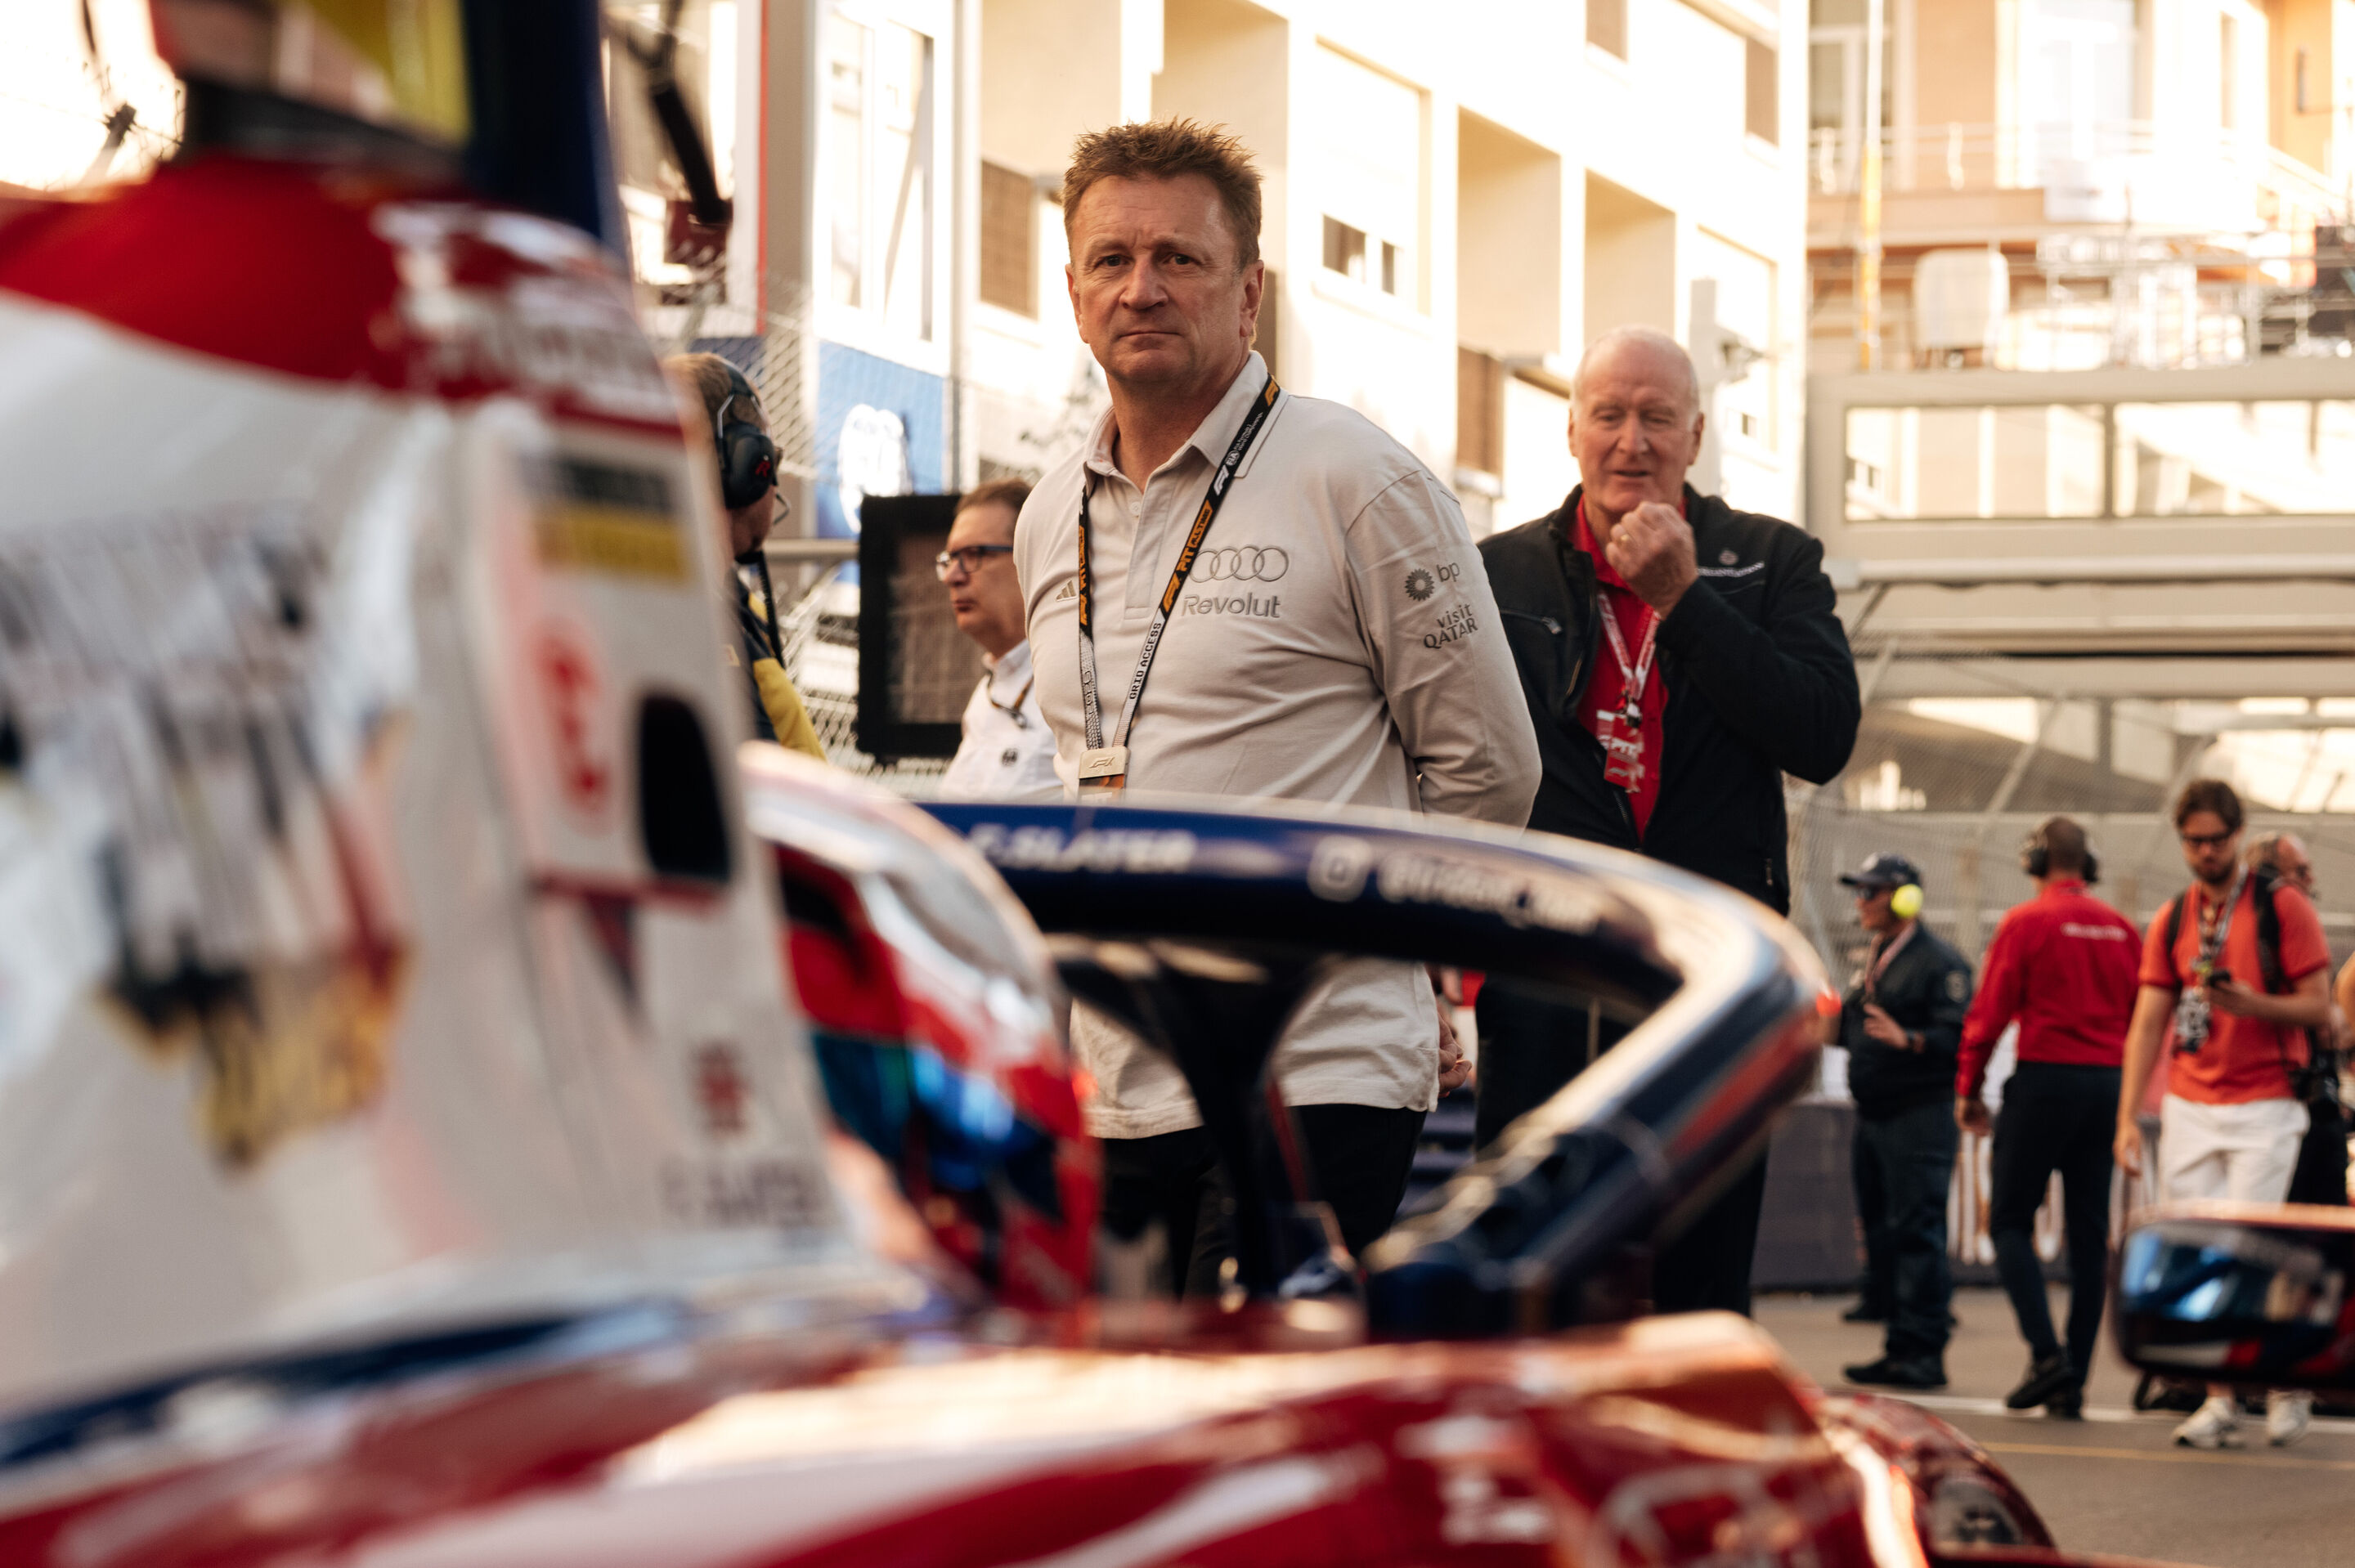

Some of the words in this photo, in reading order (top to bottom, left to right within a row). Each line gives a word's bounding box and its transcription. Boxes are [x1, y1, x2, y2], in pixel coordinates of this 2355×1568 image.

[1176, 547, 1195, 571] PIT
[1437, 562, 1460, 582] bp
[1181, 592, 1281, 618] Revolut
[1437, 603, 1473, 628] visit
[1424, 618, 1478, 649] QATAR
[1129, 670, 1145, 700] GRID
[1140, 622, 1162, 667] ACCESS
